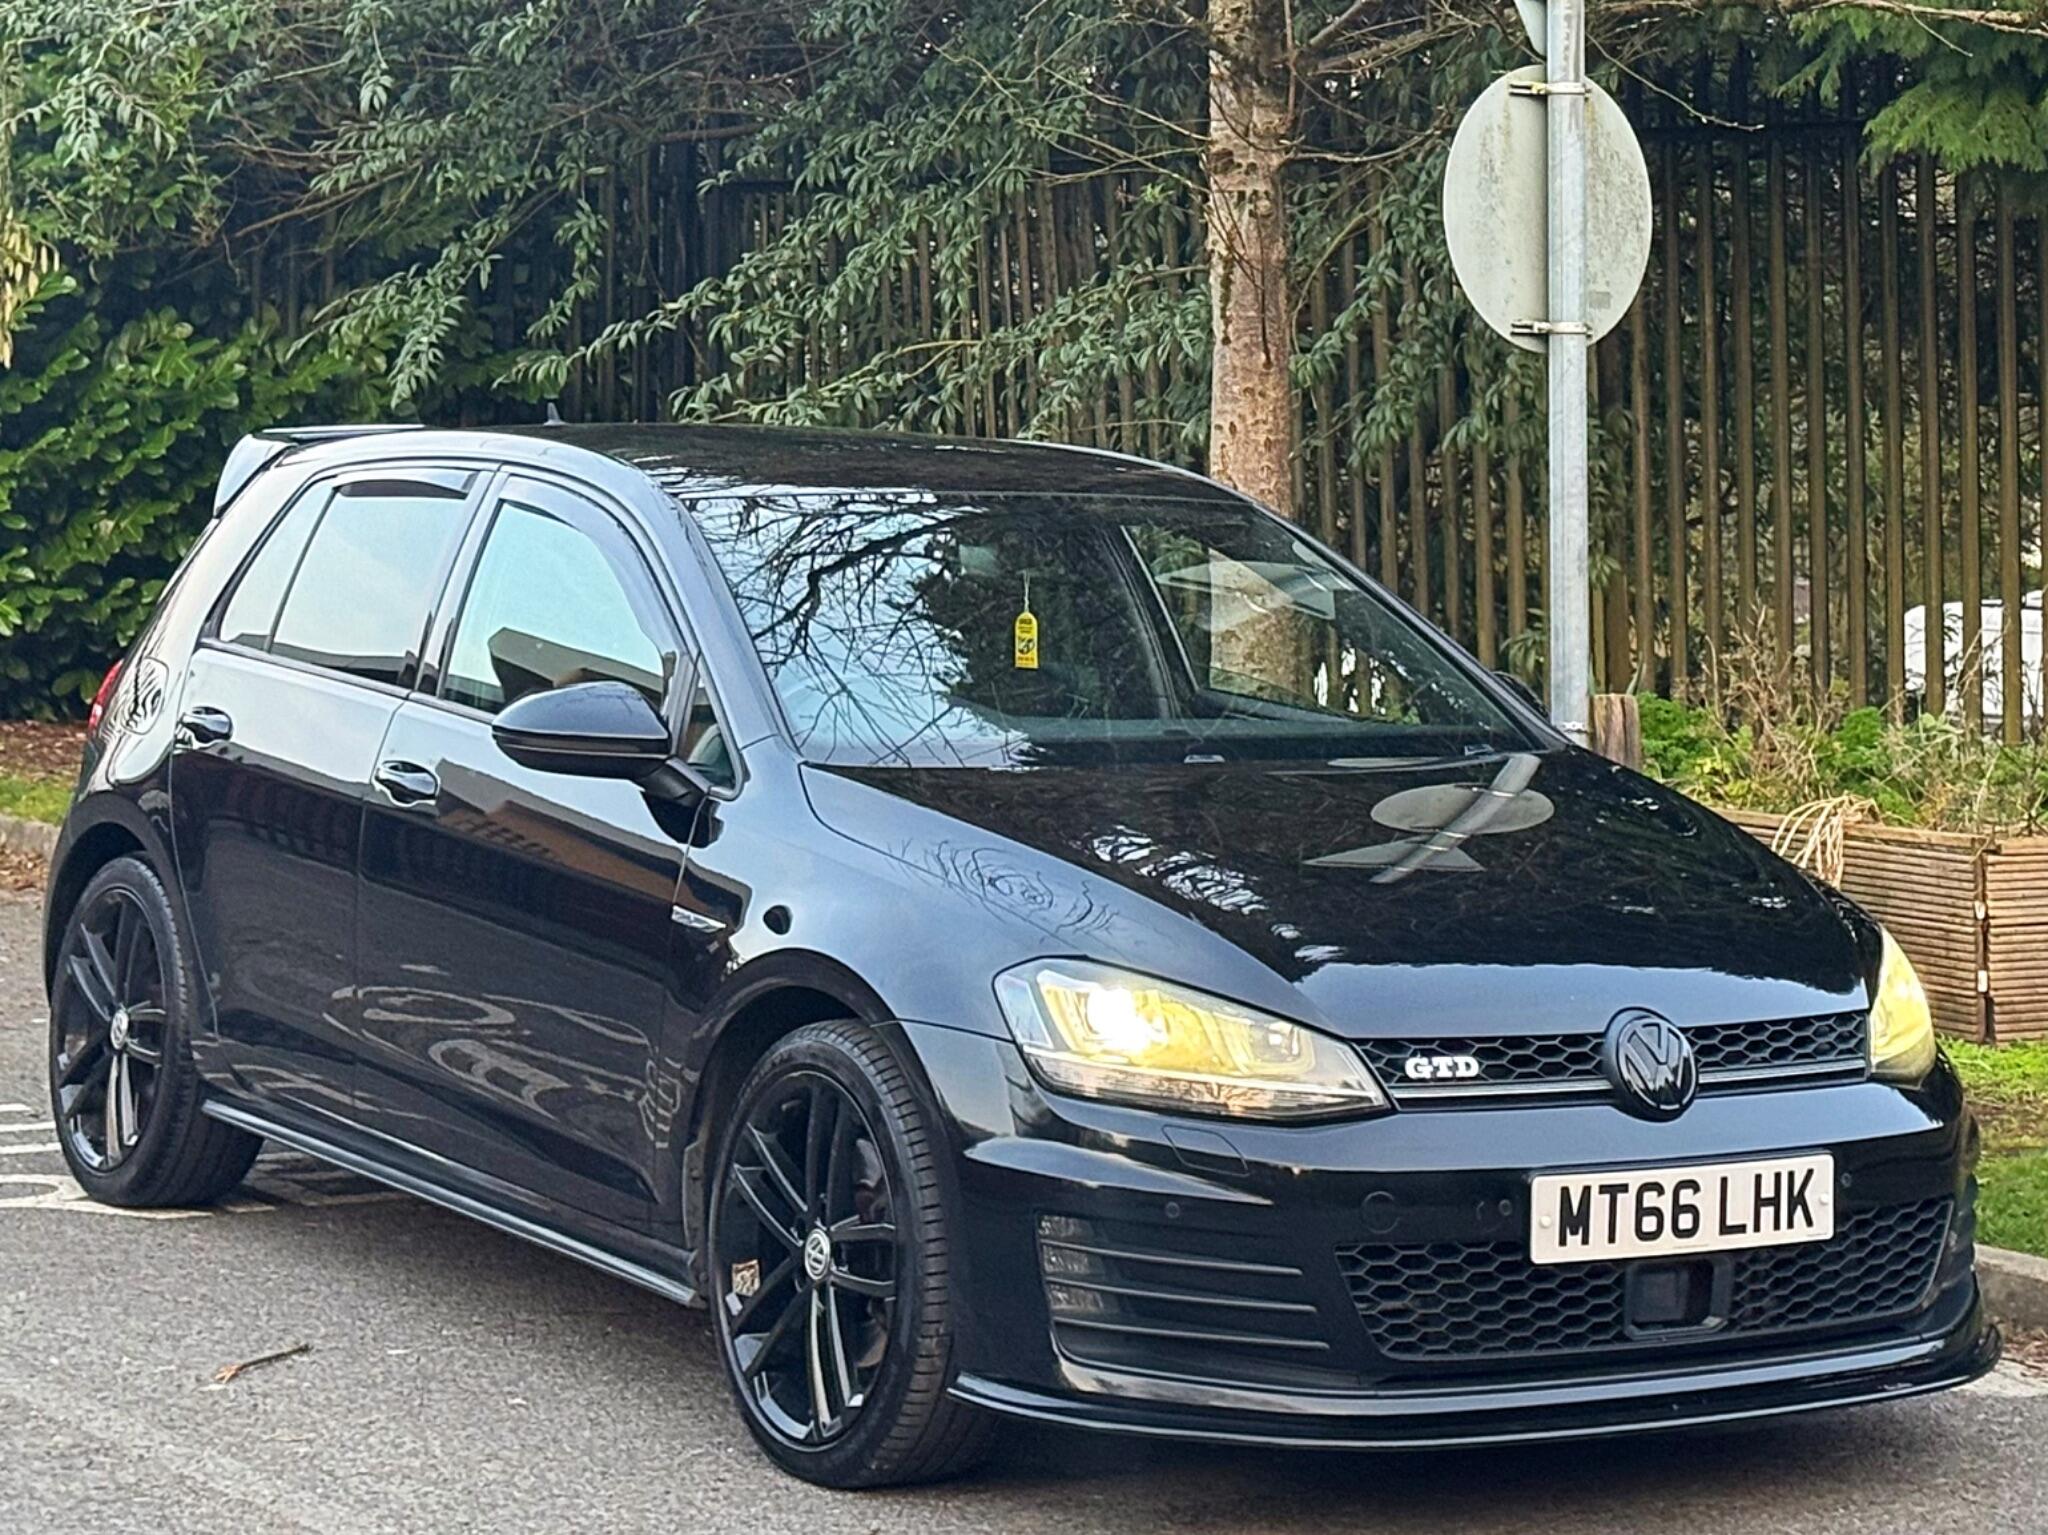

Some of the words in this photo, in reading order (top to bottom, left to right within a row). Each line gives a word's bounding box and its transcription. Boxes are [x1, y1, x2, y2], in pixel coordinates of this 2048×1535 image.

[1405, 1056, 1479, 1079] GTD
[1558, 1179, 1701, 1247] MT66
[1718, 1168, 1814, 1236] LHK
